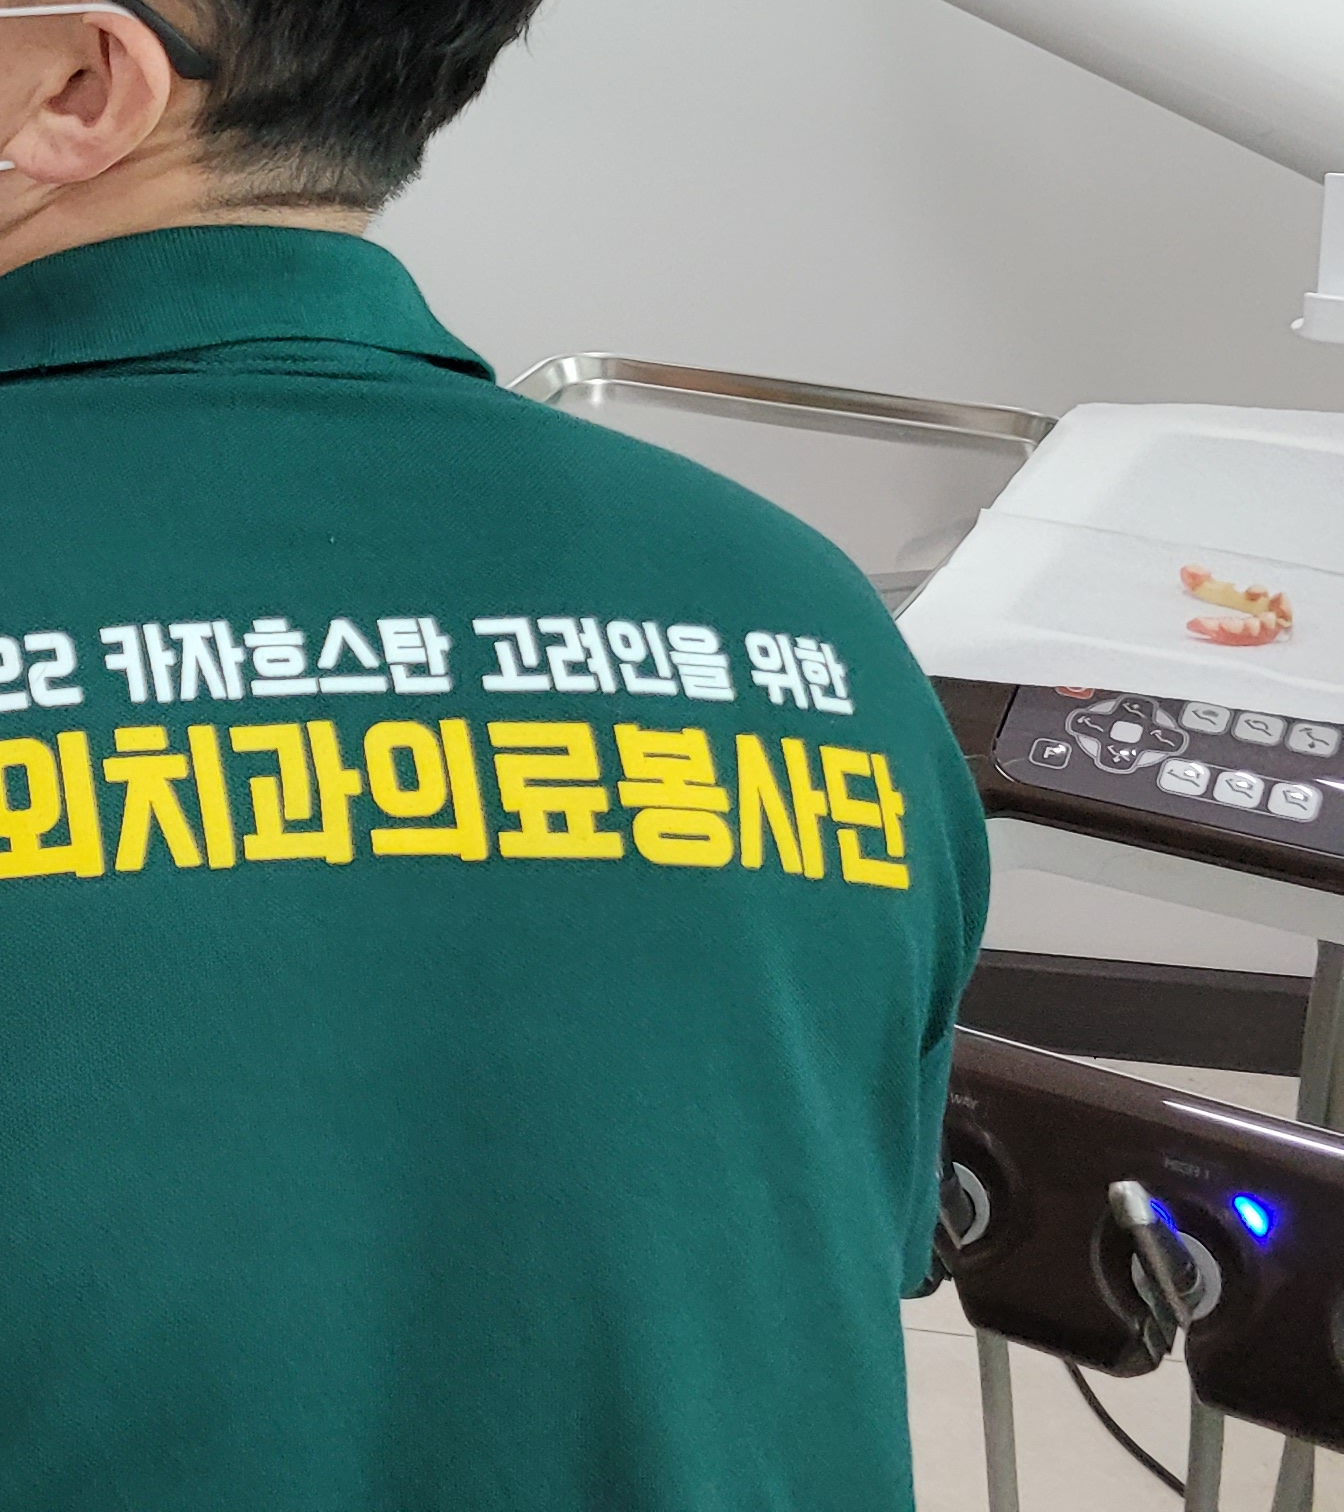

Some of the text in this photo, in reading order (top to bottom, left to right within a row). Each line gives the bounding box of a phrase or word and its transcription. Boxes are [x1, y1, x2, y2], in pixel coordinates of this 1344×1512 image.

[99, 617, 452, 703] 카자흐스탄
[472, 616, 736, 701] 고려인을
[744, 630, 854, 715] 위한
